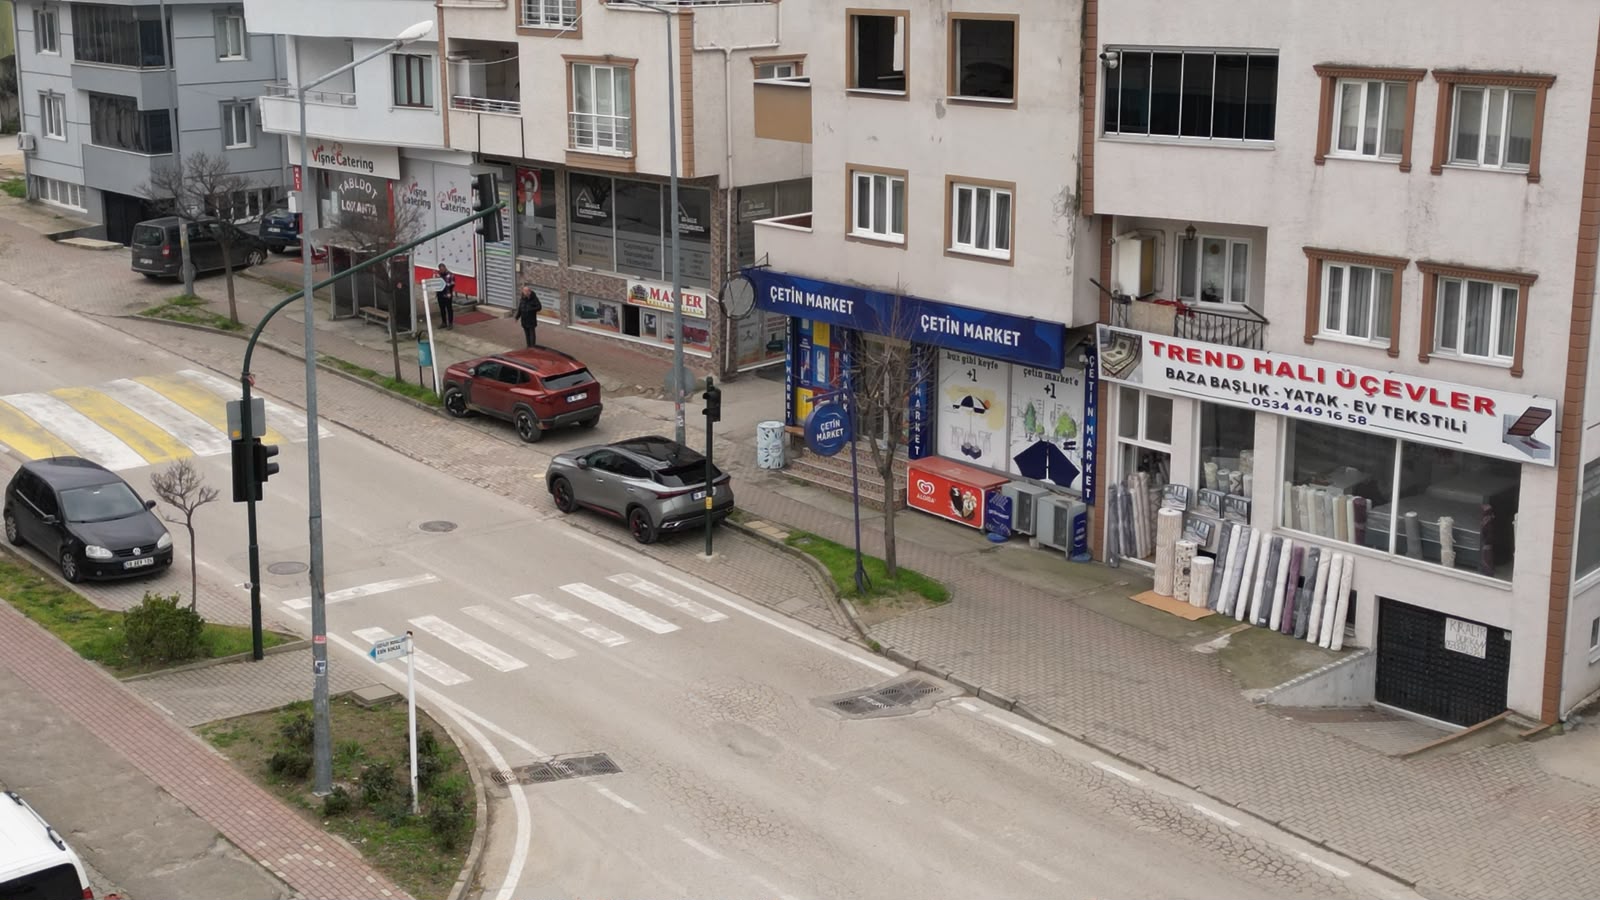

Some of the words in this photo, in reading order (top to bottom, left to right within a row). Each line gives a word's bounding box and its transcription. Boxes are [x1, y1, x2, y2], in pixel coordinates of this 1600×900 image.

[312, 146, 336, 166] Vişne
[336, 151, 374, 173] Catering
[338, 178, 377, 199] TABLDOT
[408, 183, 427, 198] Vişne
[447, 188, 466, 204] Vişne
[402, 194, 431, 210] Catering
[440, 200, 470, 216] Catering
[770, 285, 803, 305] ÇETİN
[806, 292, 854, 315] MARKET
[920, 314, 960, 336] ÇETİN
[963, 322, 1021, 347] MARKET
[966, 368, 977, 382] +1
[1023, 367, 1043, 379] çetin
[1149, 340, 1245, 371] TREND
[1253, 357, 1326, 385] HALI
[1336, 368, 1497, 417] ÜÇEVLER
[1043, 382, 1056, 399] +1
[1166, 367, 1207, 386] BAZA
[1210, 375, 1270, 396] BAŞLIK
[1283, 387, 1340, 408] YATAK
[1353, 400, 1377, 415] EV
[1251, 397, 1290, 411] 0534
[1294, 404, 1323, 416] 449
[1327, 409, 1343, 421] 16
[1347, 414, 1368, 425] 58
[820, 418, 841, 433] ÇETİN
[816, 428, 844, 442] MARKET
[1085, 425, 1094, 498] MARKET
